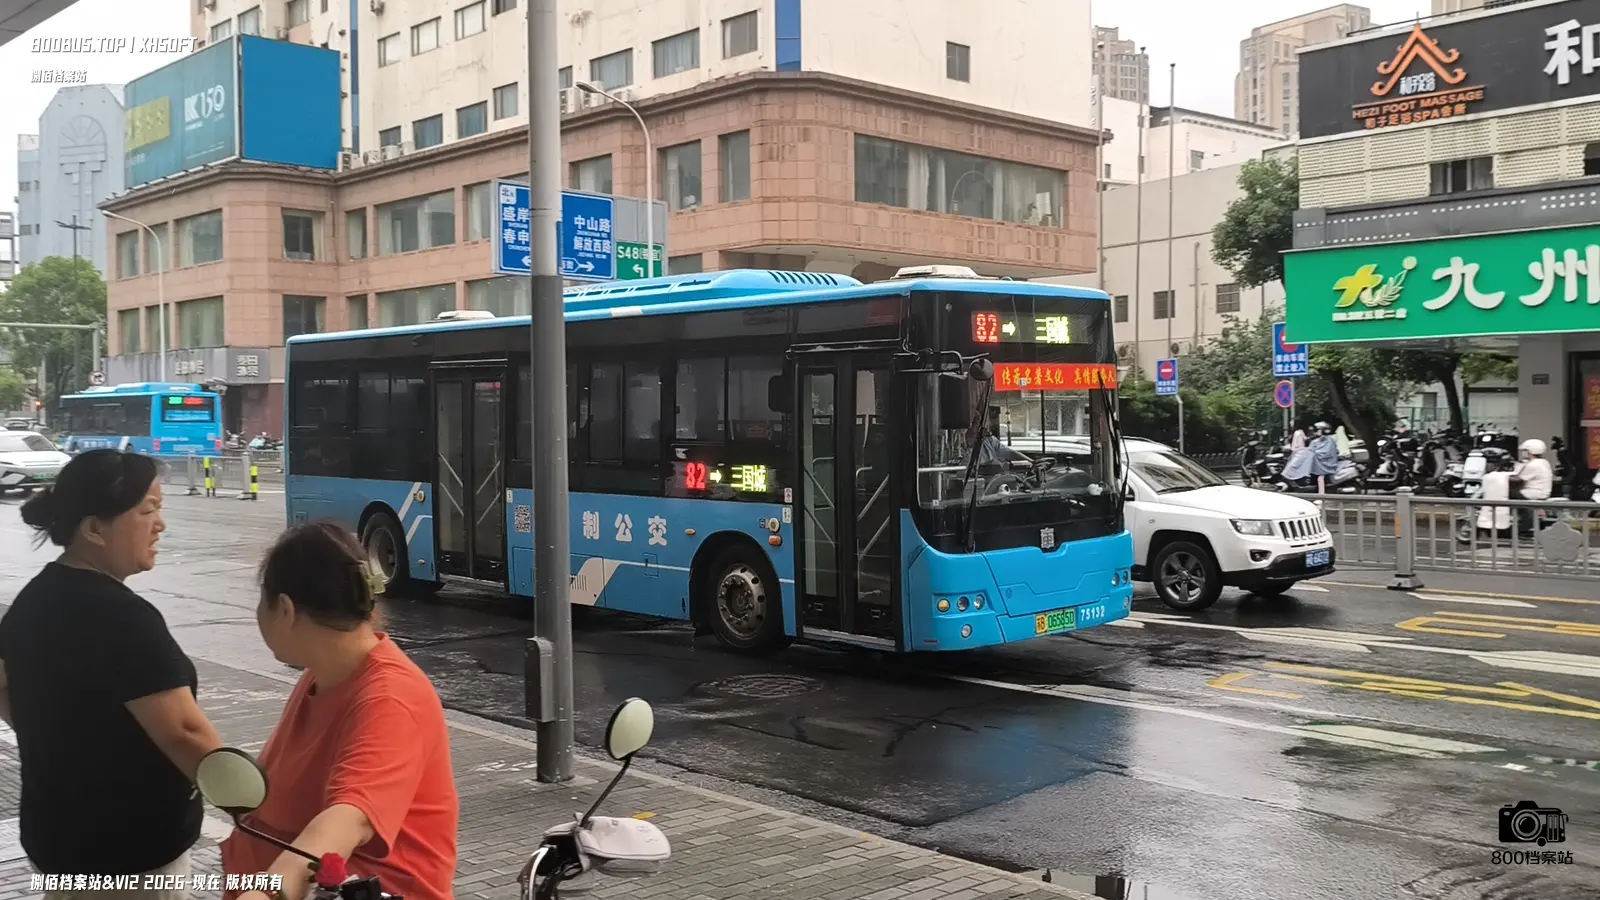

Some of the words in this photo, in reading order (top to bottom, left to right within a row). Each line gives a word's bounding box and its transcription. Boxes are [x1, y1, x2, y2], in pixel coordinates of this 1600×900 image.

[1352, 107, 1380, 119] HEZI
[1382, 100, 1417, 114] FOOT
[1420, 90, 1484, 108] MASSAGE
[573, 214, 611, 233] 中山路
[573, 235, 611, 254] 解放西路
[617, 246, 640, 260] S48
[975, 313, 999, 342] 82
[686, 462, 706, 489] 82
[731, 464, 767, 492] 三国城
[1080, 604, 1105, 622] 75132
